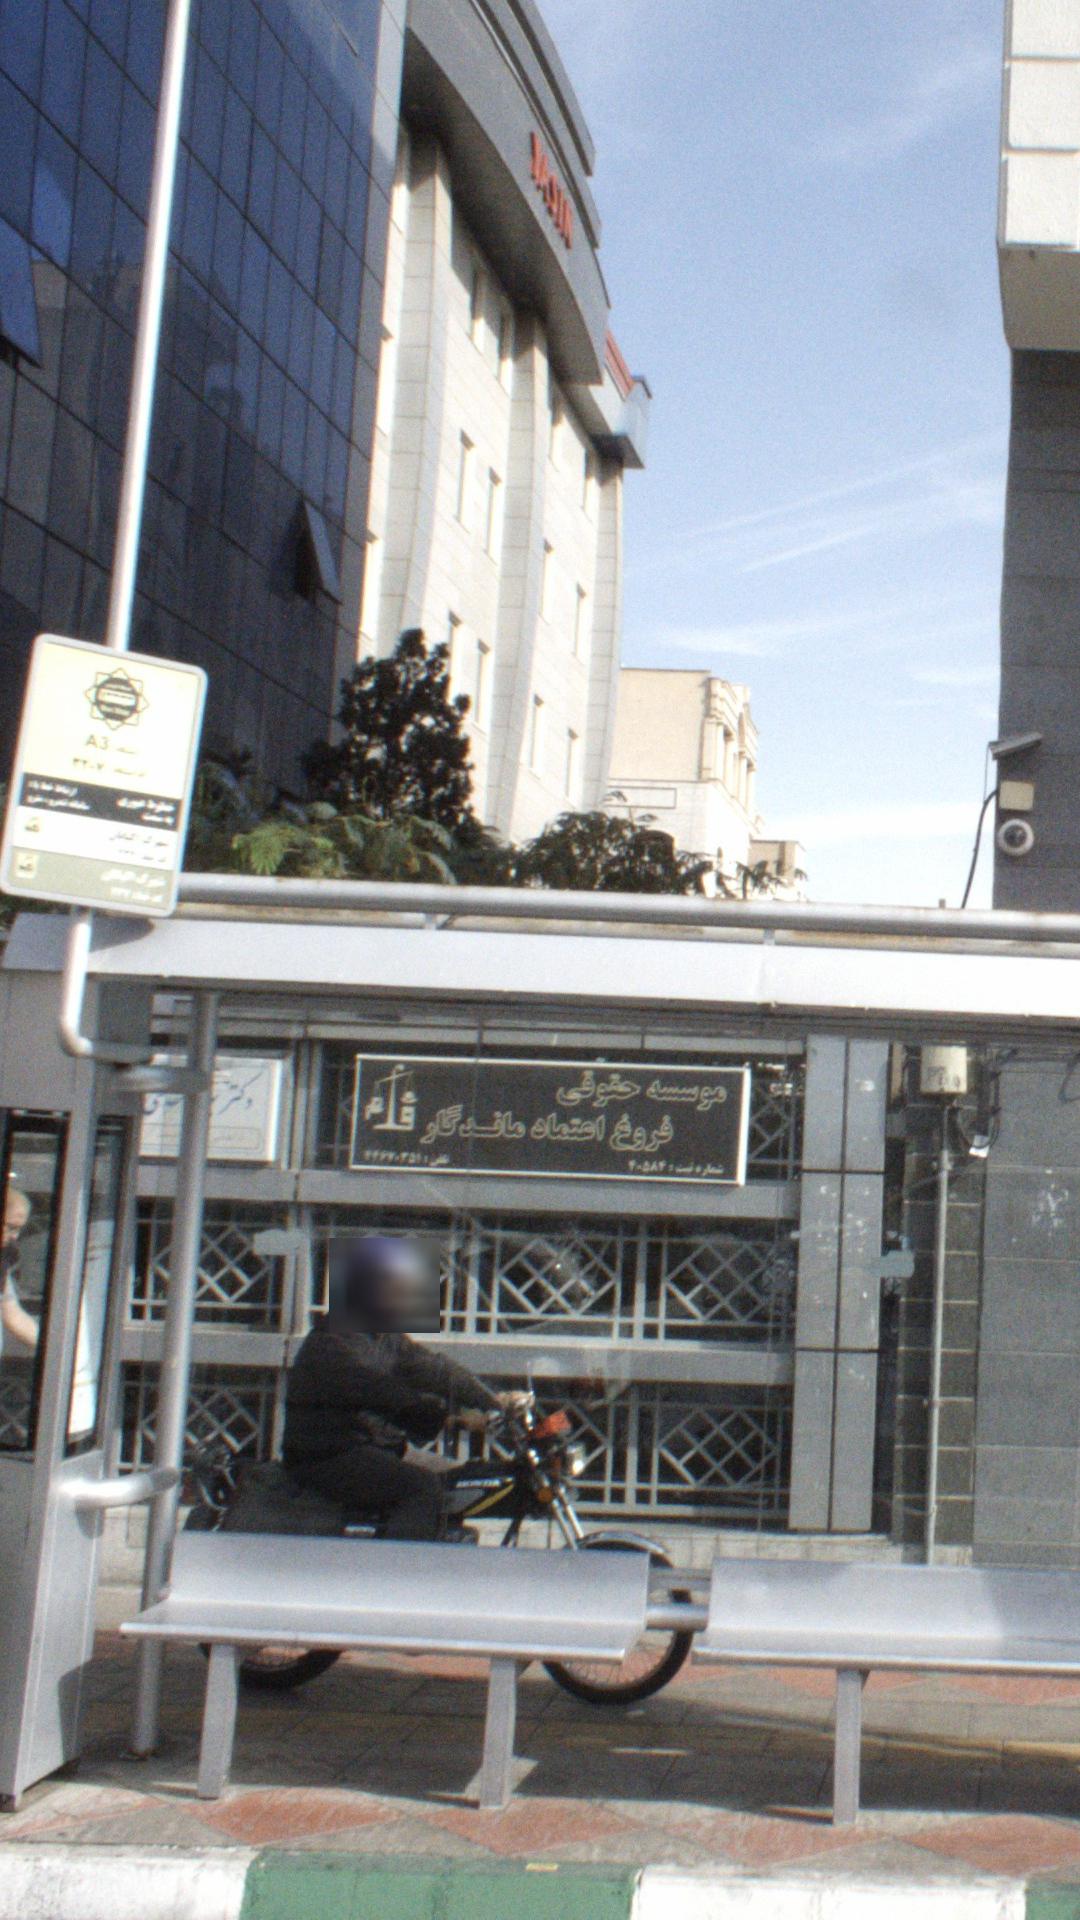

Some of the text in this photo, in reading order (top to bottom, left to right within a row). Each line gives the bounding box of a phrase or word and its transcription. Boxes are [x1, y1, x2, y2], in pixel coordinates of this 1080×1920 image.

[556, 1070, 728, 1111] موسسه حقوقی
[419, 1104, 674, 1152] فروغ اعتماد ماندگار
